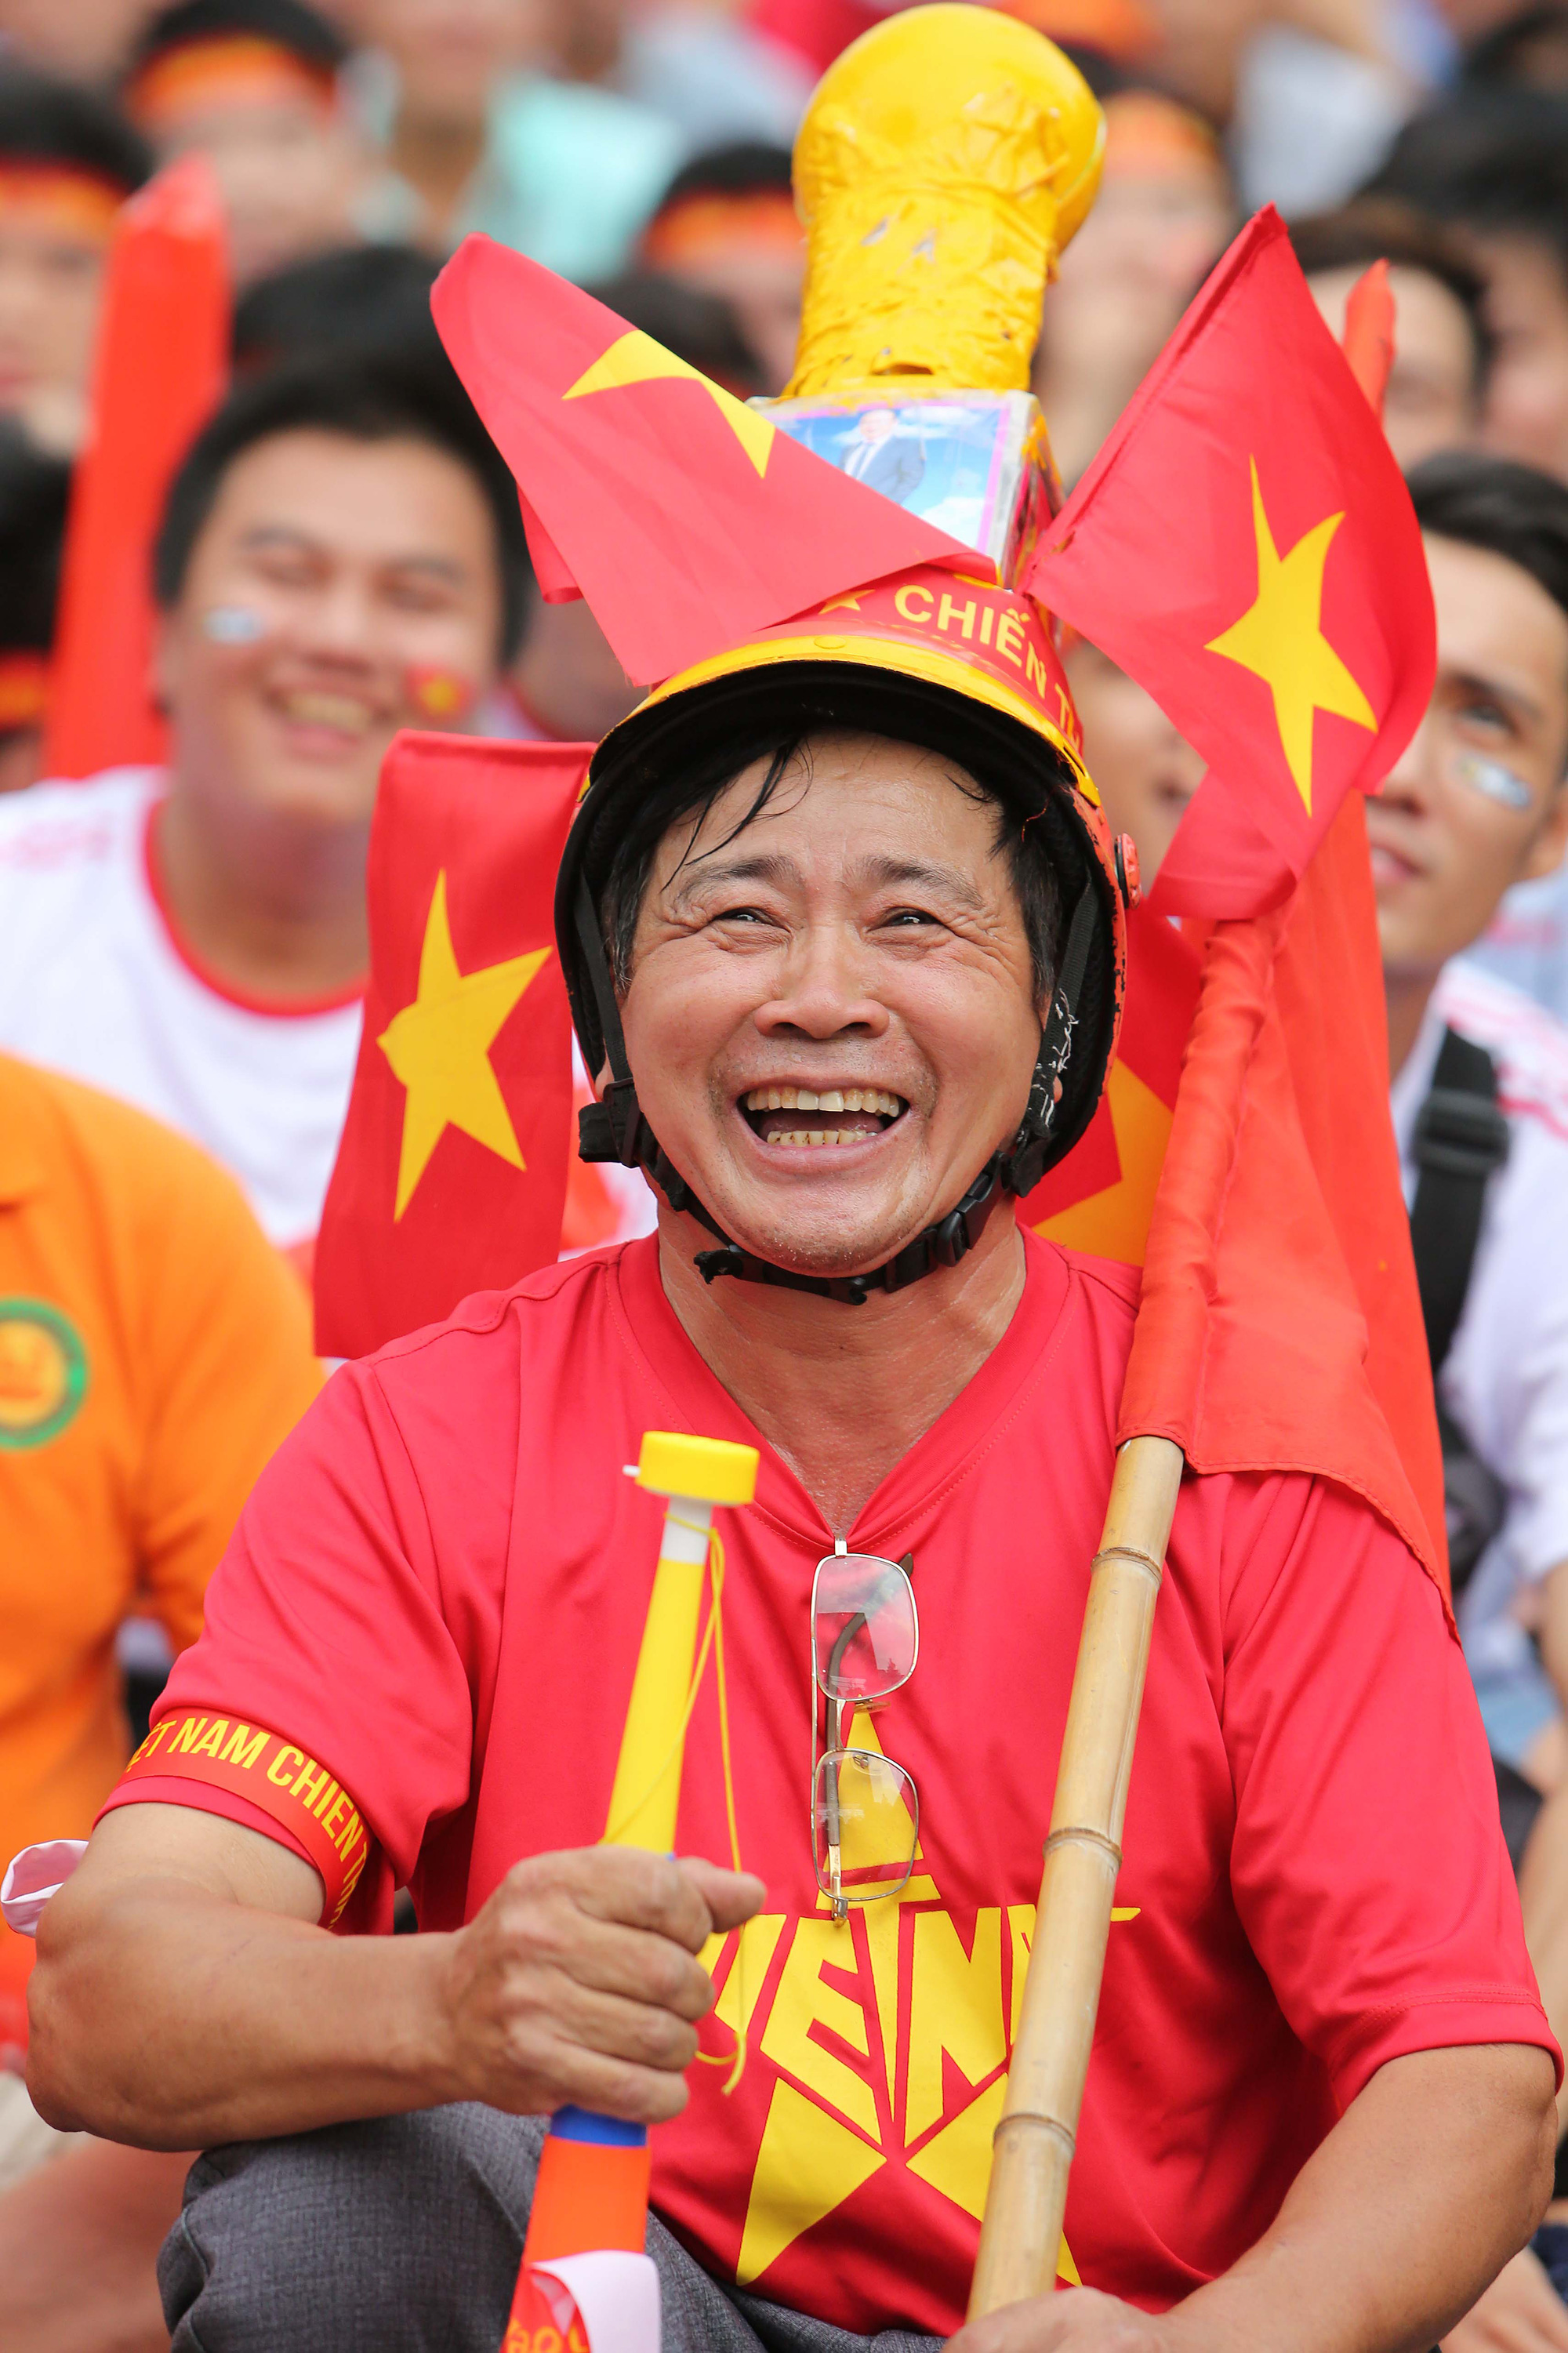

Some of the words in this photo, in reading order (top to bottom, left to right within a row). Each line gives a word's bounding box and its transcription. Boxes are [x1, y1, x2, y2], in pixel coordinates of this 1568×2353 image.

[895, 584, 1047, 699] CHIẾN
[125, 1719, 177, 1774] ỆT
[165, 1716, 271, 1770] NAM
